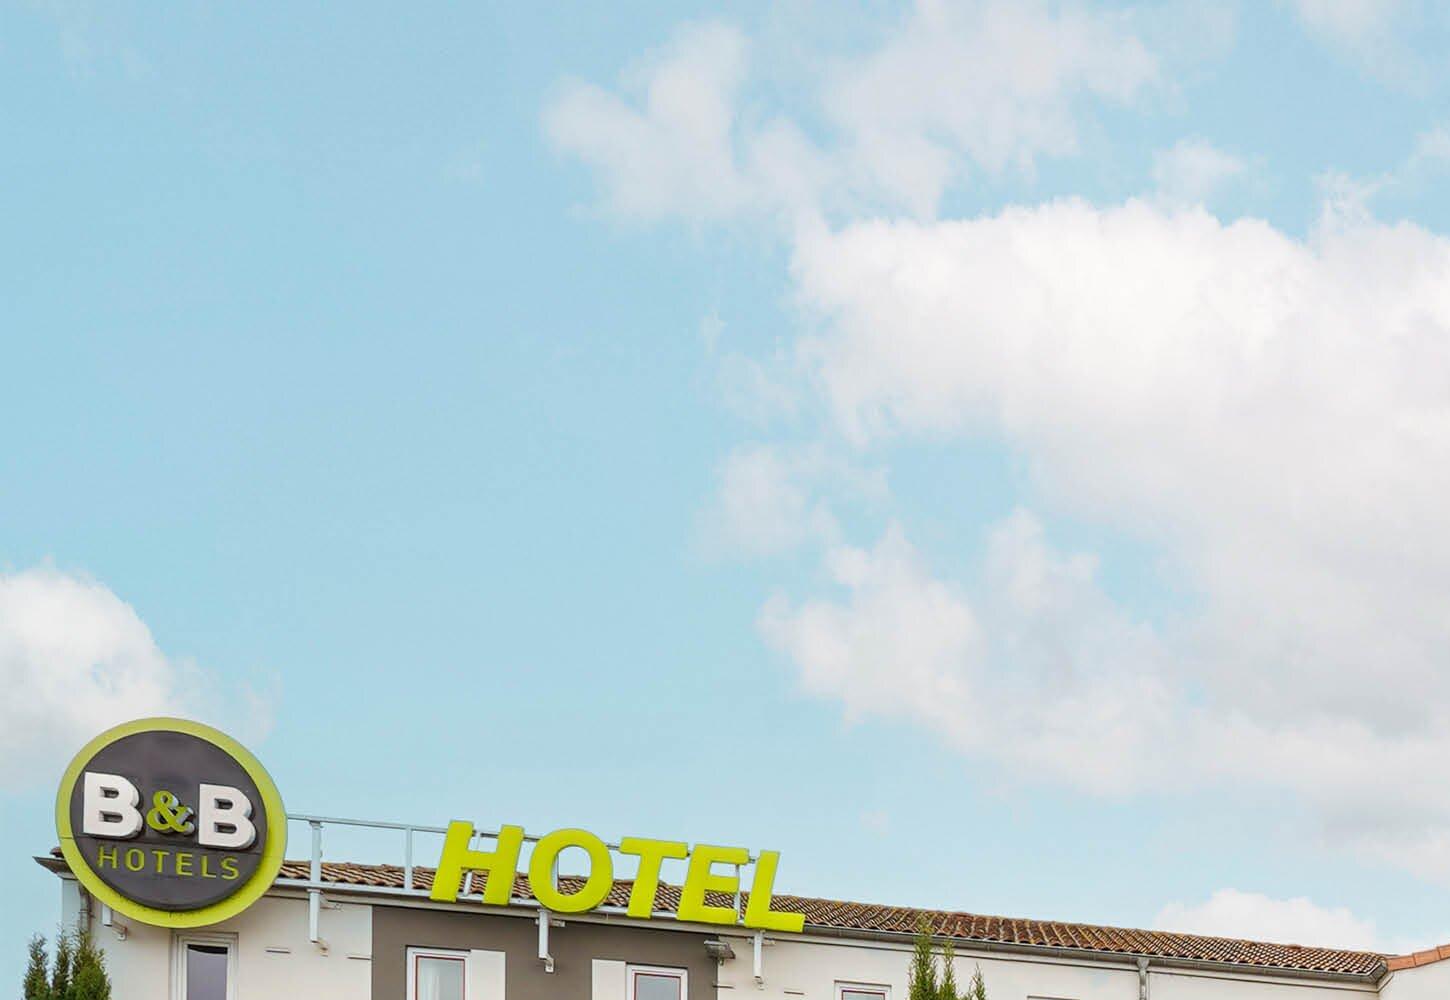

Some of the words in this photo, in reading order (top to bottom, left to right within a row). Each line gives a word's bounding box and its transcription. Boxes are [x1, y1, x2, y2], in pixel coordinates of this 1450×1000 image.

[83, 771, 257, 849] B&B
[98, 845, 240, 880] HOTELS
[430, 820, 805, 932] HOTEL
